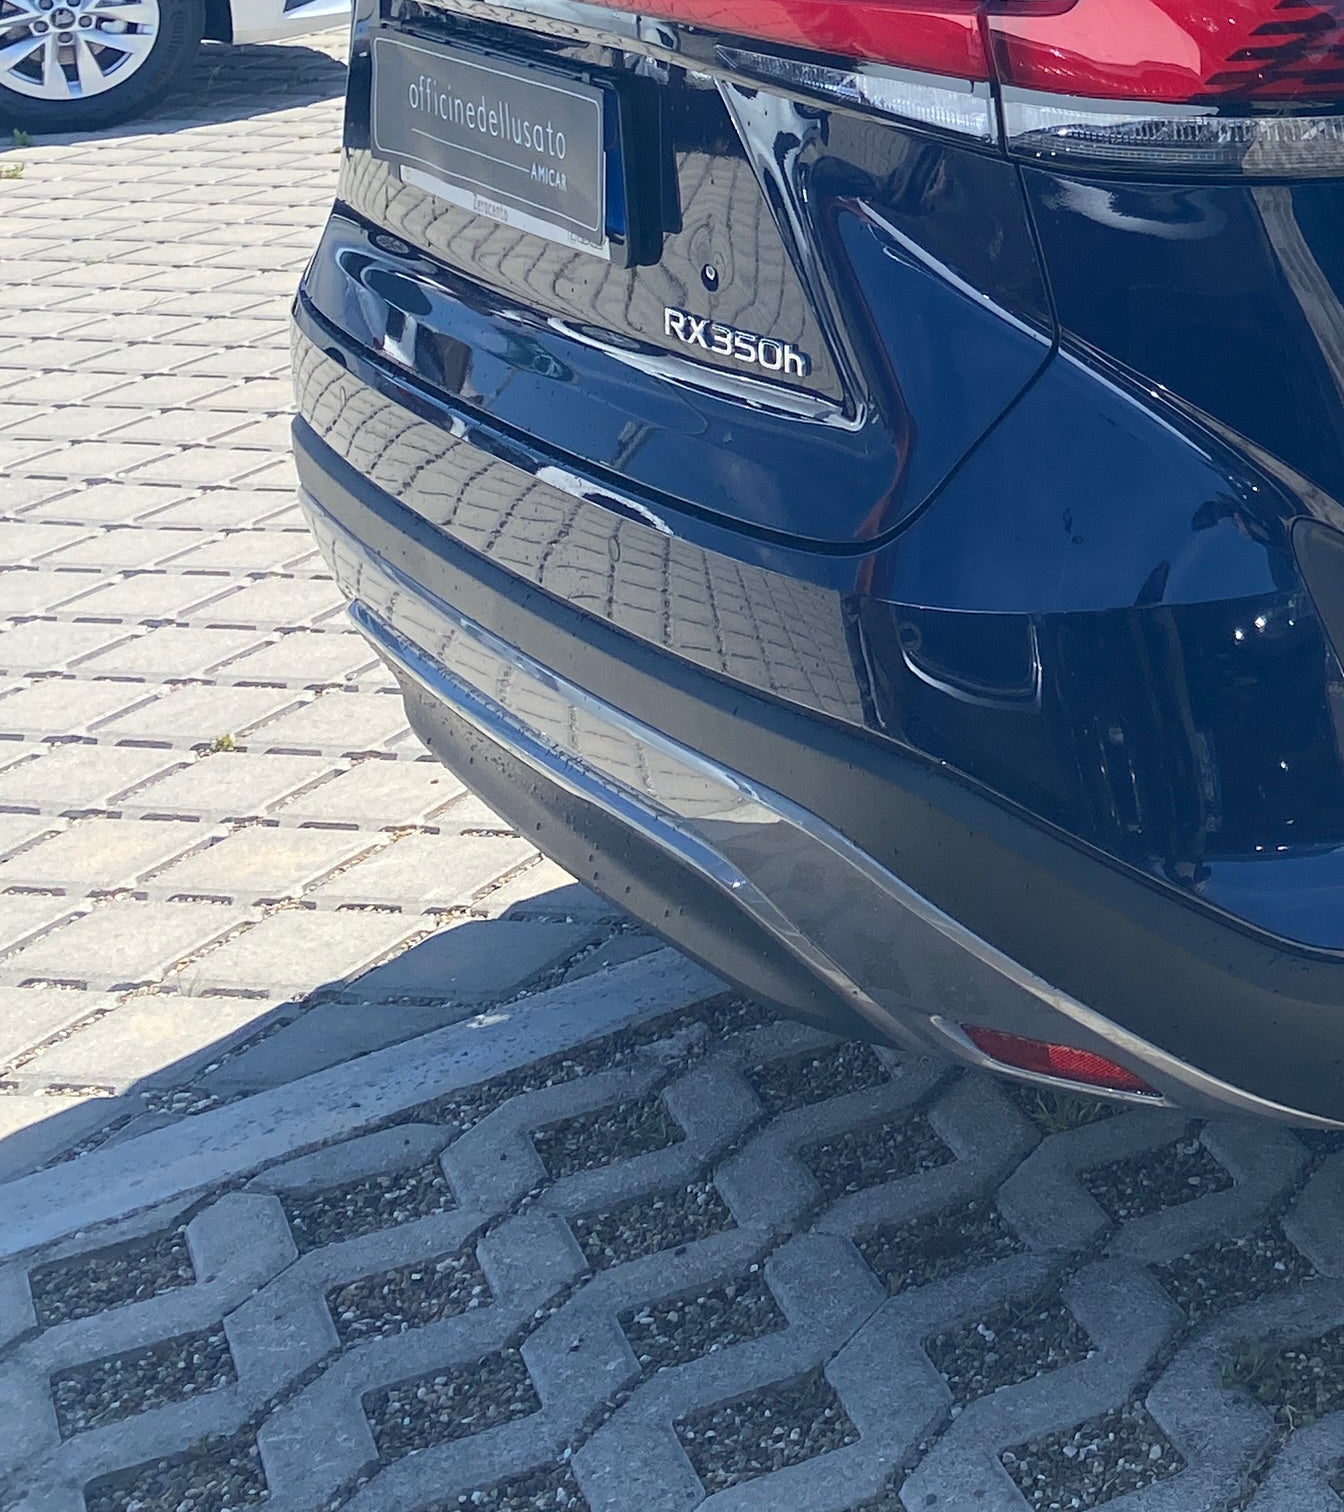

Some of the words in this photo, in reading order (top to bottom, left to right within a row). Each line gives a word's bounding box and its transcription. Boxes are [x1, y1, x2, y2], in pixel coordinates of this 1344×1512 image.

[408, 75, 567, 160] officinedellusato
[530, 163, 568, 192] AMICAR
[664, 306, 813, 377] RX350h
